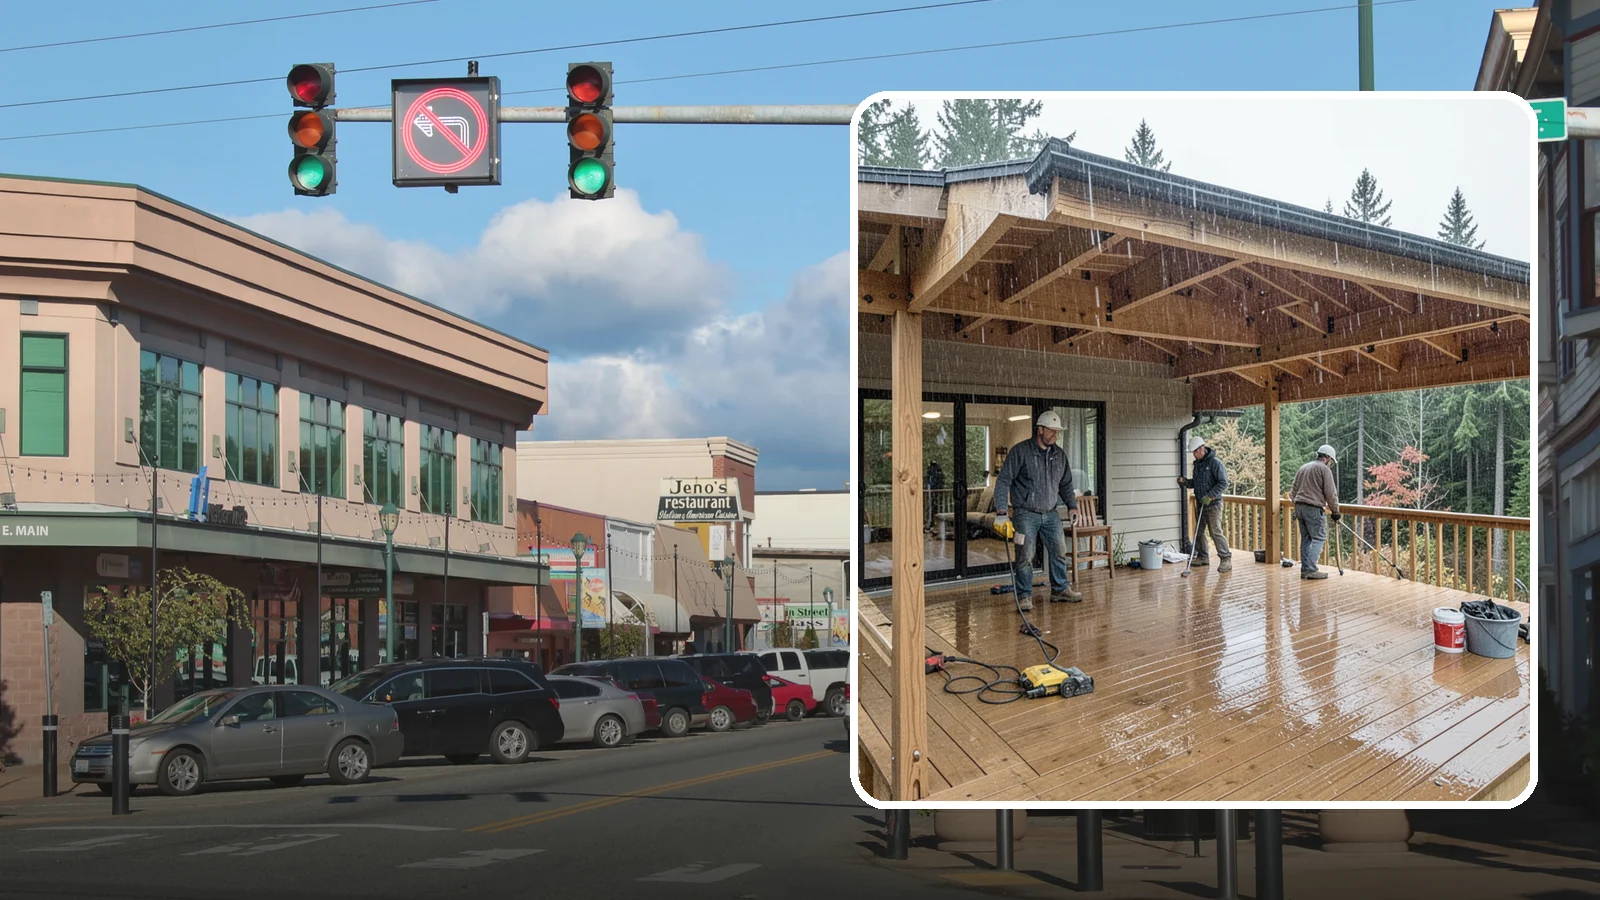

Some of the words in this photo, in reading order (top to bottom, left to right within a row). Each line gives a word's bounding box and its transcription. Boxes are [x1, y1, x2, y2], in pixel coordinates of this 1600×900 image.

[670, 480, 727, 494] Jeno's
[665, 496, 731, 509] restaurant
[659, 510, 681, 519] Italian
[686, 510, 714, 519] American
[715, 510, 737, 519] Cuisine
[2, 525, 13, 536] E.
[15, 525, 49, 536] MAIN
[785, 607, 795, 616] in
[797, 608, 828, 616] Street
